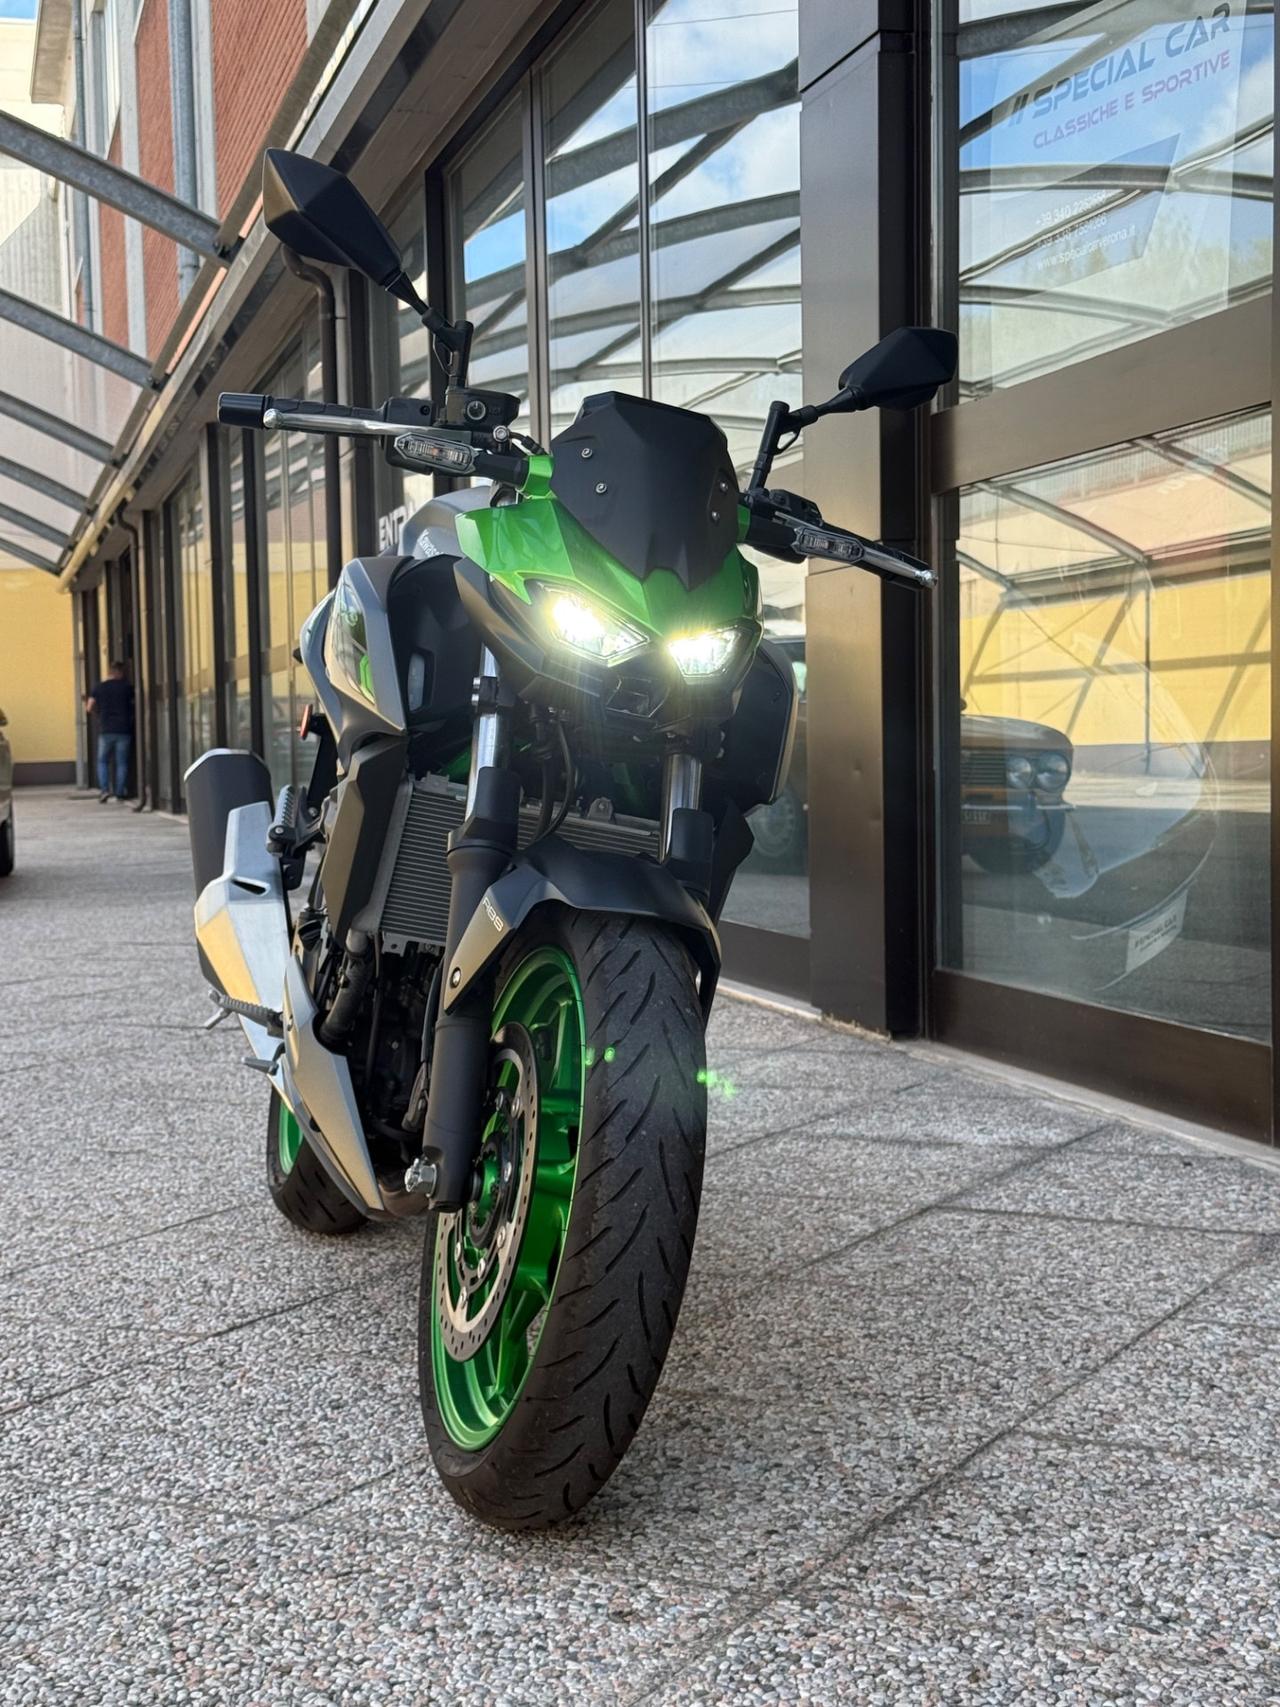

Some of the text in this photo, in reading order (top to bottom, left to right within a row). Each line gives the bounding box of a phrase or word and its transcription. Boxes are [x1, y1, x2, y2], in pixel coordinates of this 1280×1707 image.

[1165, 2, 1231, 58] CAR
[1033, 50, 1231, 149] CLASSICHE E SPORTIVE
[483, 897, 504, 932] ABS
